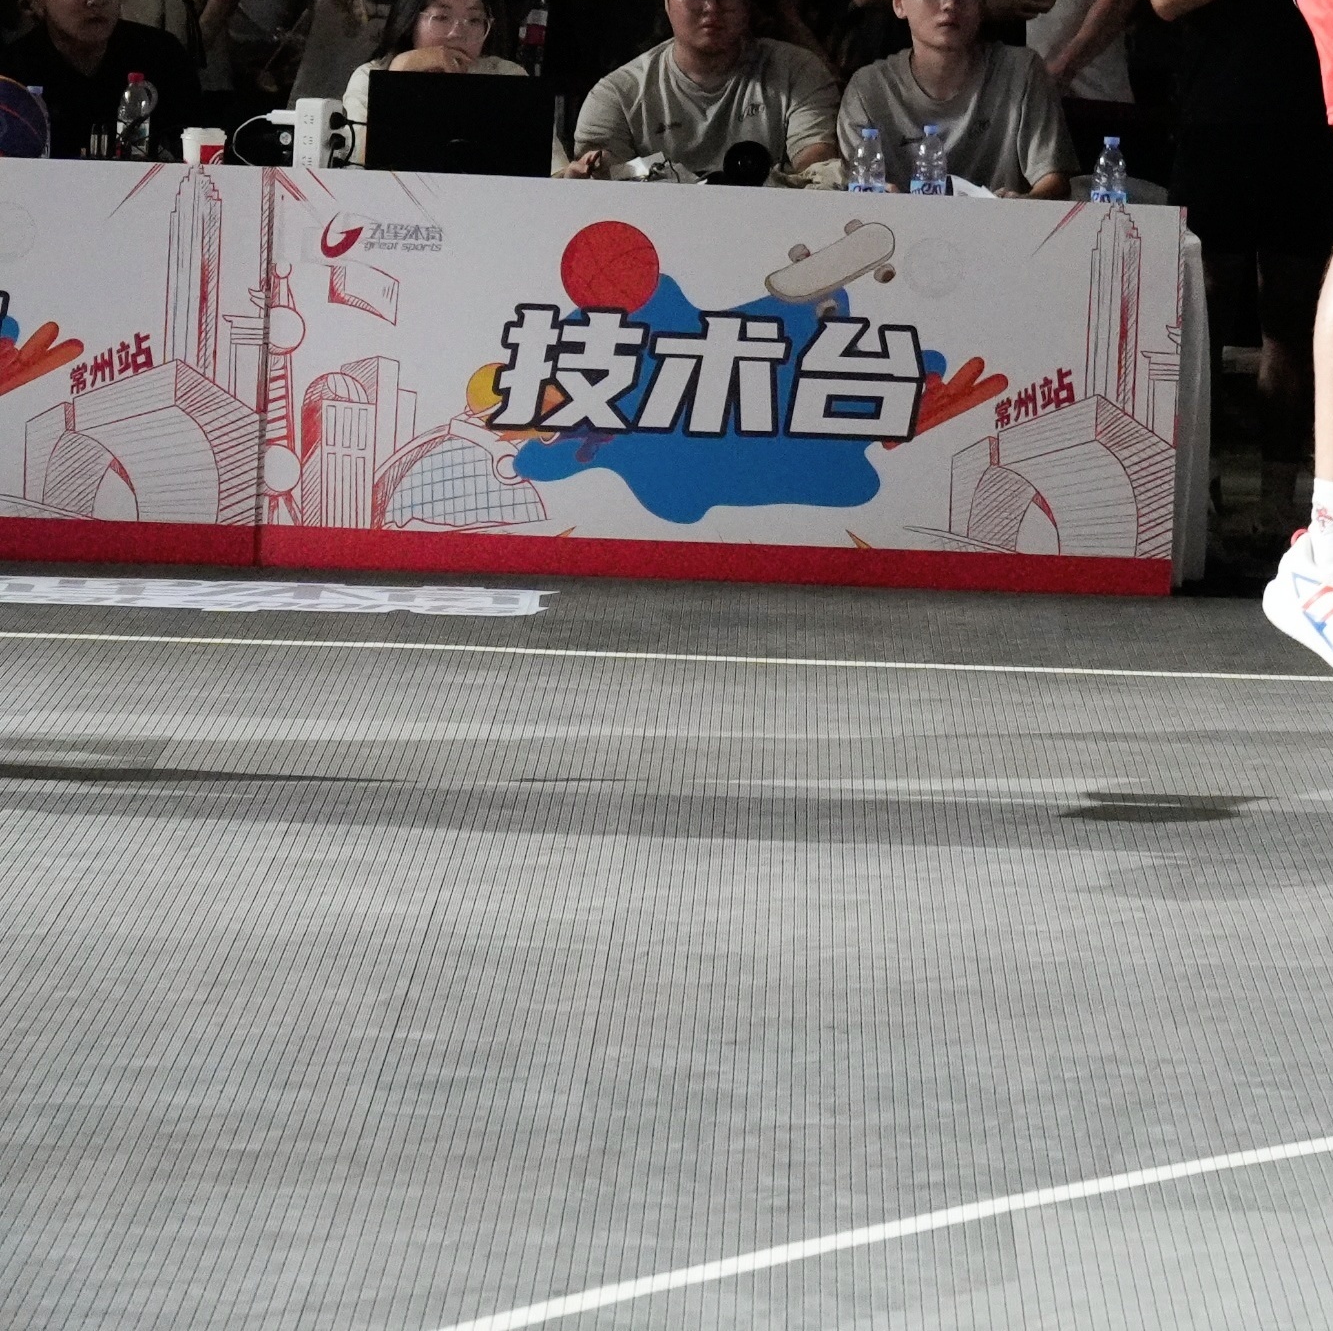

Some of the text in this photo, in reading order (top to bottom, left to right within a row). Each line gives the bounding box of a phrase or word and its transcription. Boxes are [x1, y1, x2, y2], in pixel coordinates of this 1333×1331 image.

[363, 241, 442, 252] great sports
[365, 222, 443, 242] 五星体育
[69, 331, 154, 395] 常州站
[487, 302, 926, 441] 技术台
[994, 367, 1076, 430] 常州站
[0, 577, 520, 606] 星体育
